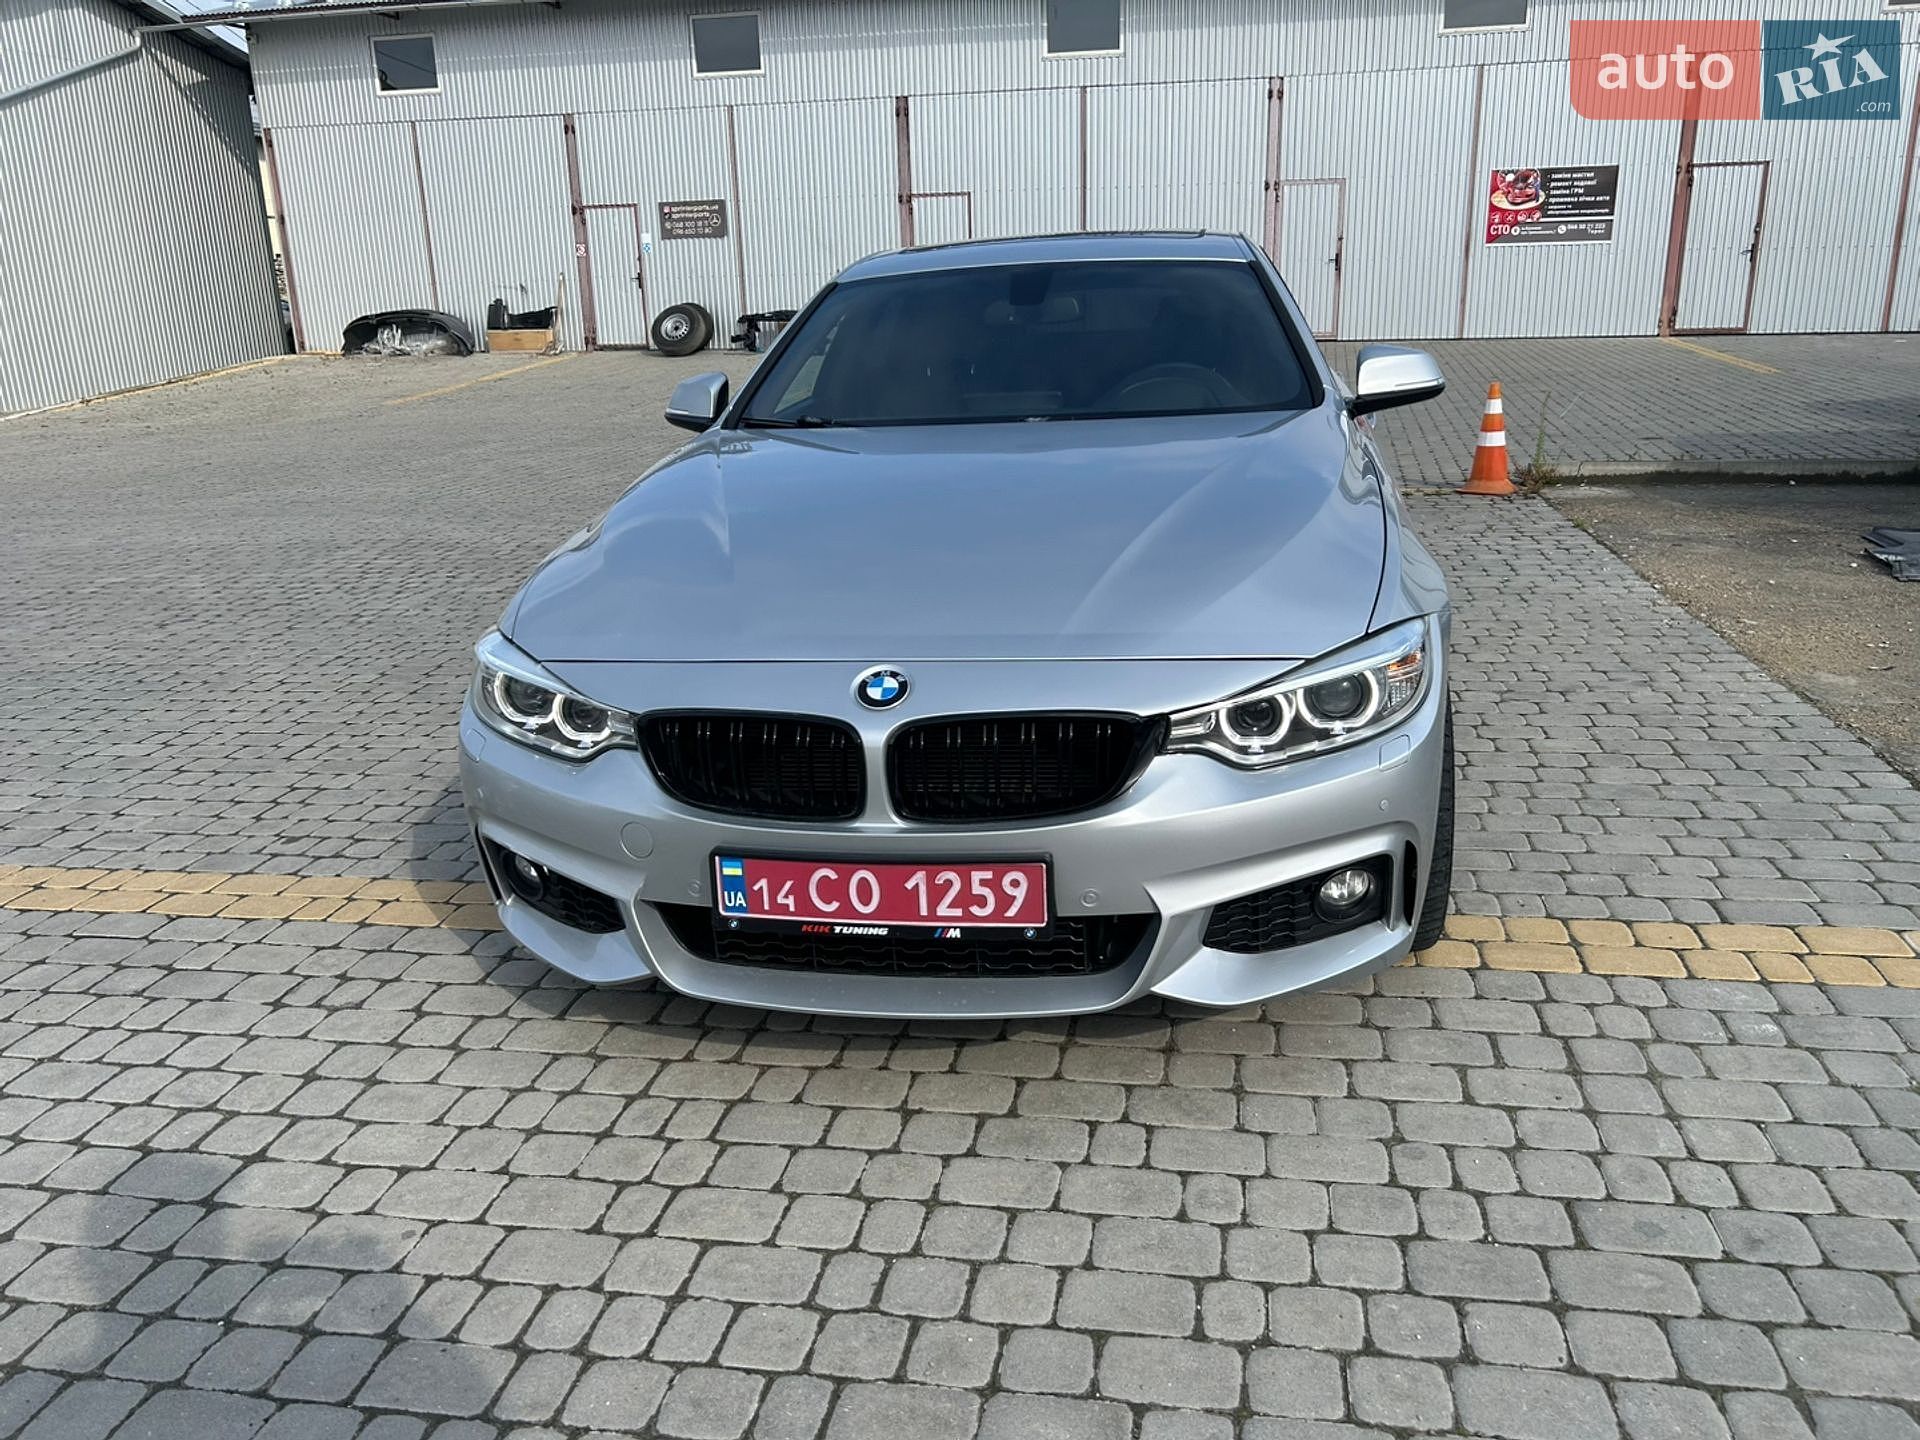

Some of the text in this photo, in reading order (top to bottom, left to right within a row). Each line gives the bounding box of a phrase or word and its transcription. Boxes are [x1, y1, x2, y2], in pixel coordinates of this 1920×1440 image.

[1490, 223, 1510, 235] СТО
[724, 891, 746, 908] UA
[808, 867, 881, 915] CO
[904, 870, 1029, 918] 1259
[833, 925, 888, 936] TUNING
